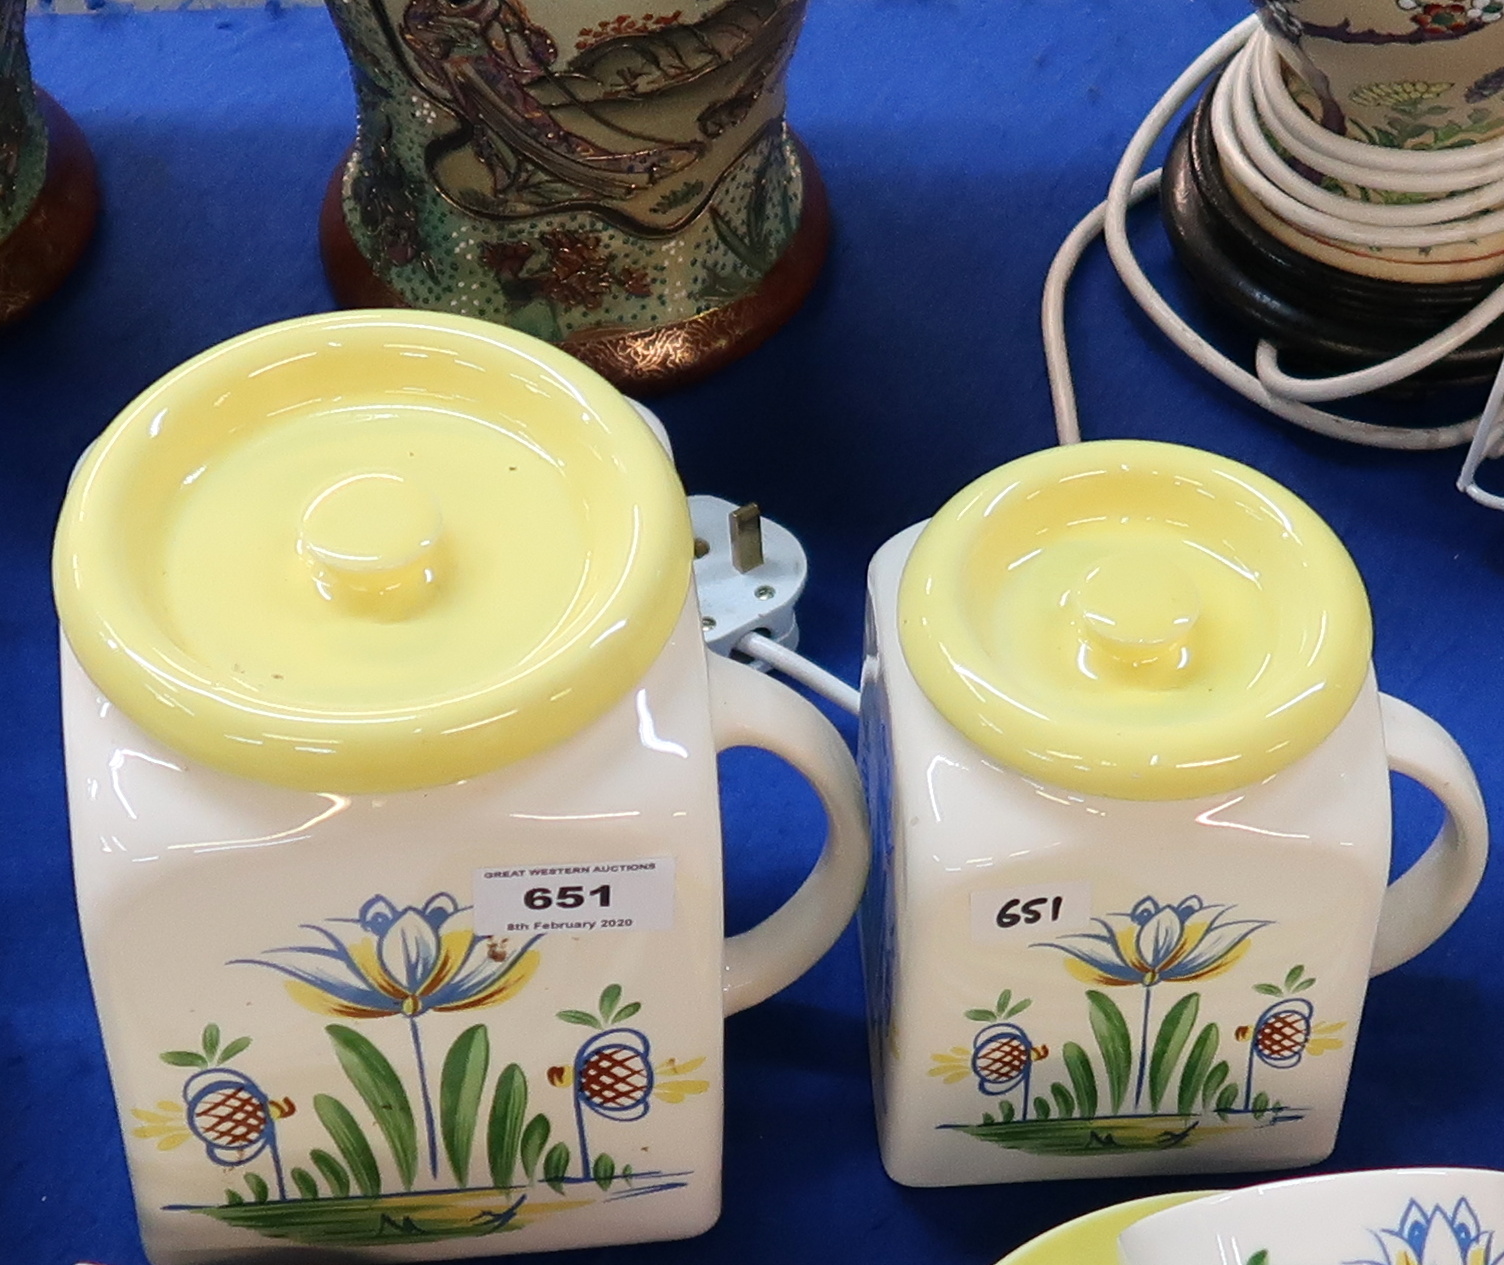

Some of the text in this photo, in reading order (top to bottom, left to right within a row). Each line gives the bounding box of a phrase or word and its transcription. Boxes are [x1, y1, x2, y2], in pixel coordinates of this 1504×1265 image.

[483, 862, 656, 879] GREAT WESTERN AUCTIONS
[523, 884, 611, 910] 651
[996, 896, 1063, 928] 651
[507, 918, 633, 931] 8th February 2020
